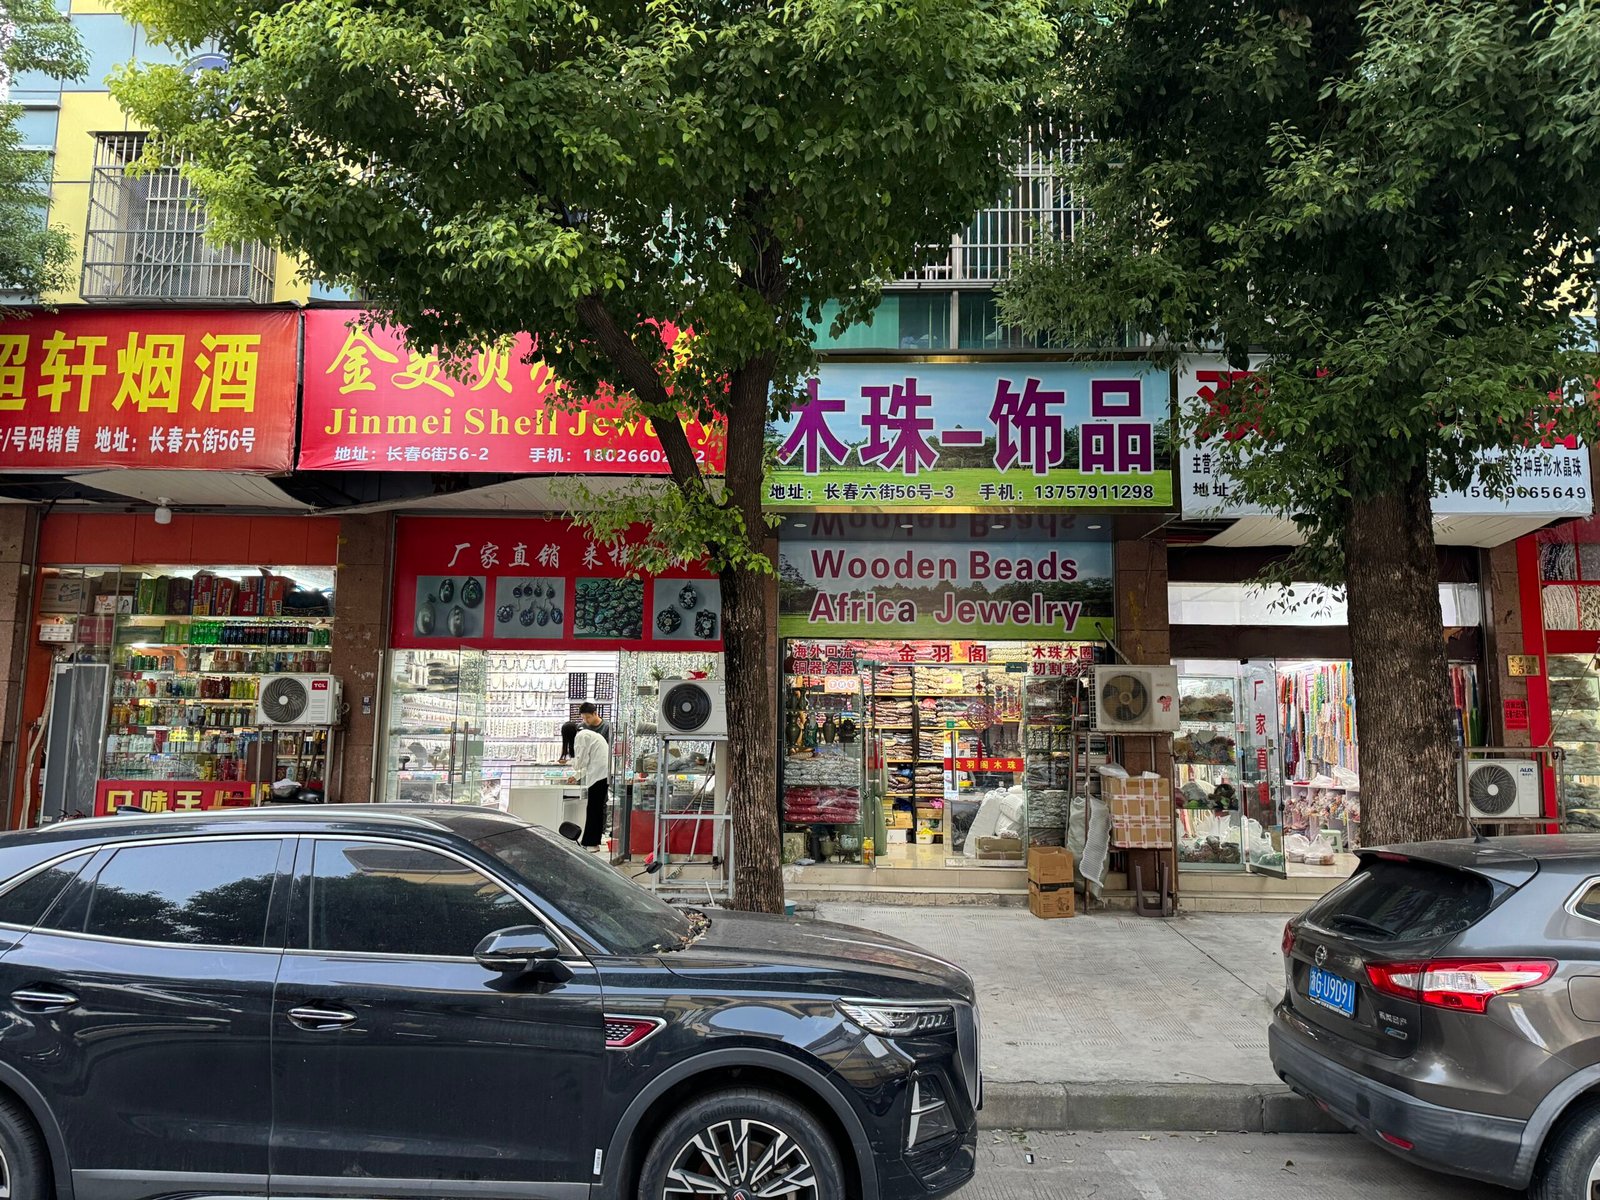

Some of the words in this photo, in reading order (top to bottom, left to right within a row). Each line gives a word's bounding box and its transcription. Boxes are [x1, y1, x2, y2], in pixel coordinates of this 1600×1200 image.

[0, 426, 80, 453] /号码销售
[324, 408, 452, 435] Jinmei
[464, 408, 557, 436] Shell
[569, 410, 715, 445] Jewery
[448, 543, 560, 568] 厂家直销
[582, 541, 691, 572] 来样
[810, 549, 957, 580] Wooden
[969, 550, 1078, 580] Beads
[809, 592, 916, 623] Africa
[935, 593, 1081, 632] Jewelry
[794, 645, 853, 658] 海外回流
[794, 661, 853, 674] 铜器瓷器
